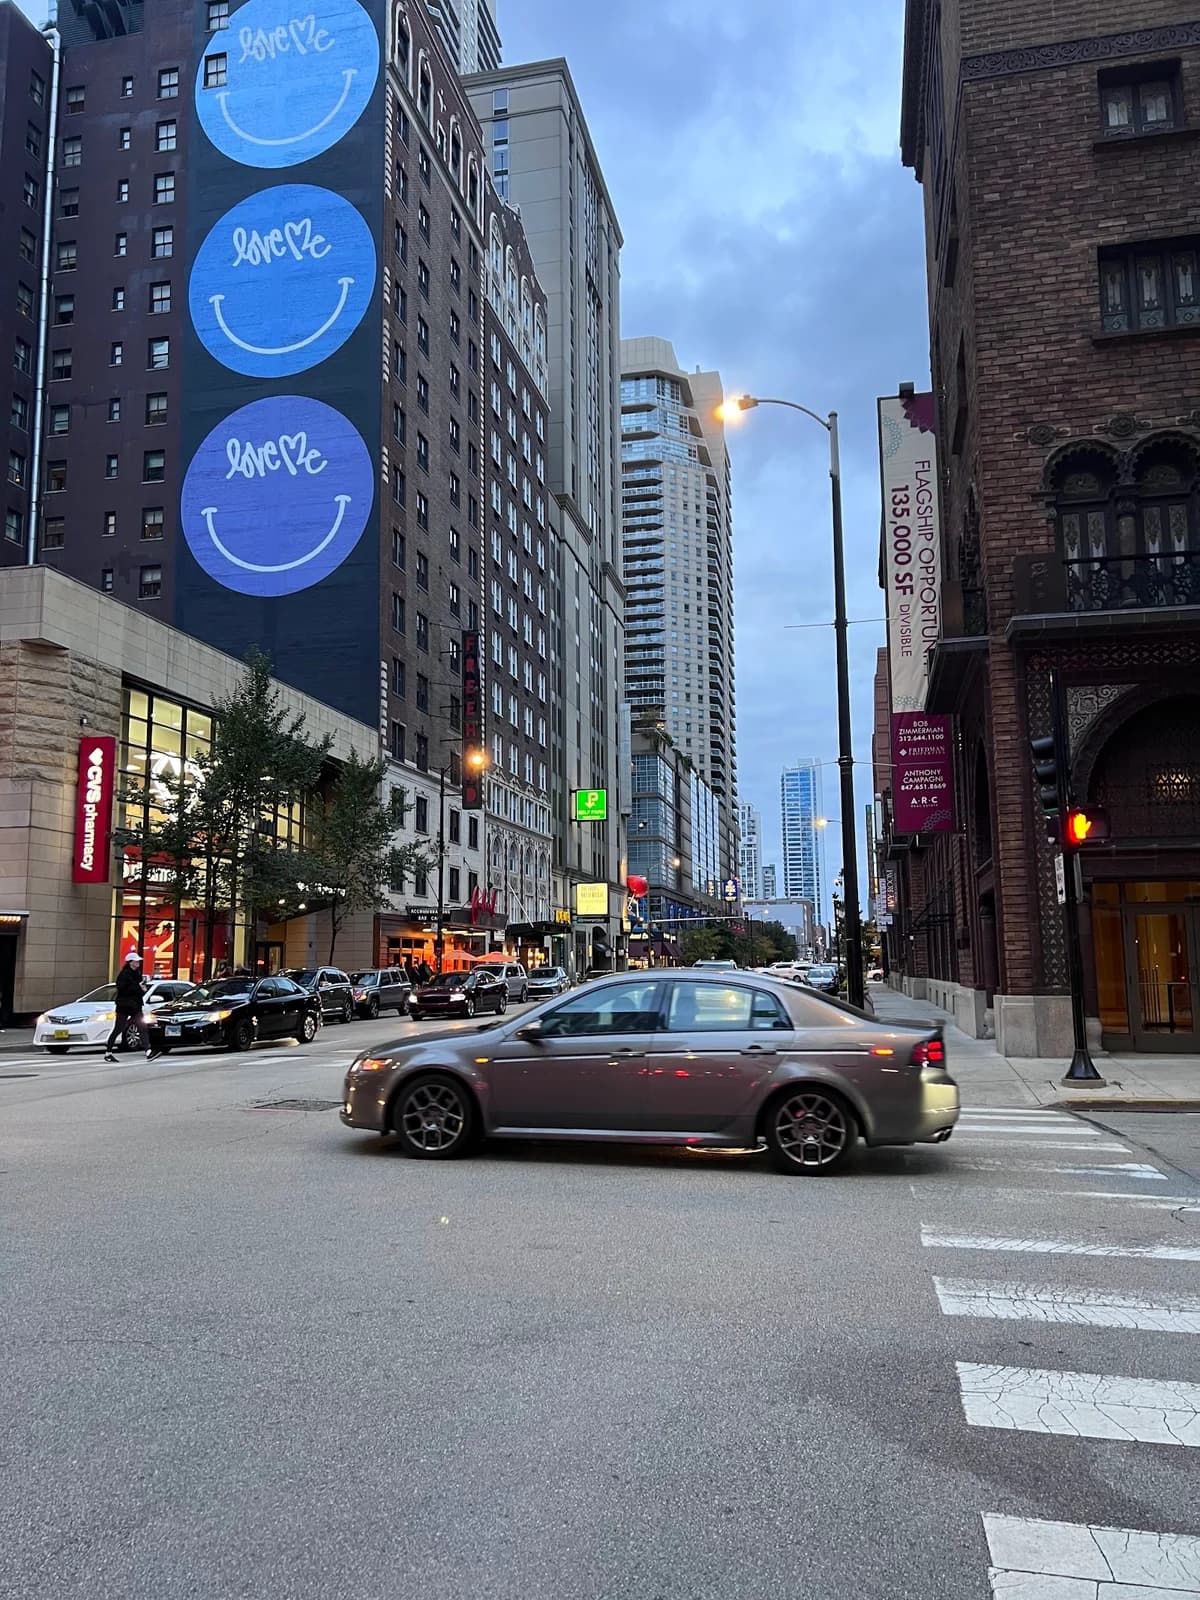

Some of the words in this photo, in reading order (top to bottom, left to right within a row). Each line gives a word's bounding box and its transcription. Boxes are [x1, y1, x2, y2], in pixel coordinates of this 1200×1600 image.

[914, 460, 934, 542] FLAGSHIP
[890, 484, 912, 566] 135,000
[895, 572, 914, 596] SF
[899, 604, 912, 657] DIVISIBLE
[918, 547, 939, 677] OPPORTUN
[898, 727, 944, 735] ZIMMERMAN
[899, 734, 944, 742] 312.644.1100
[86, 765, 103, 803] CVS
[904, 769, 941, 777] ANTHONY
[80, 804, 98, 872] pharmacy
